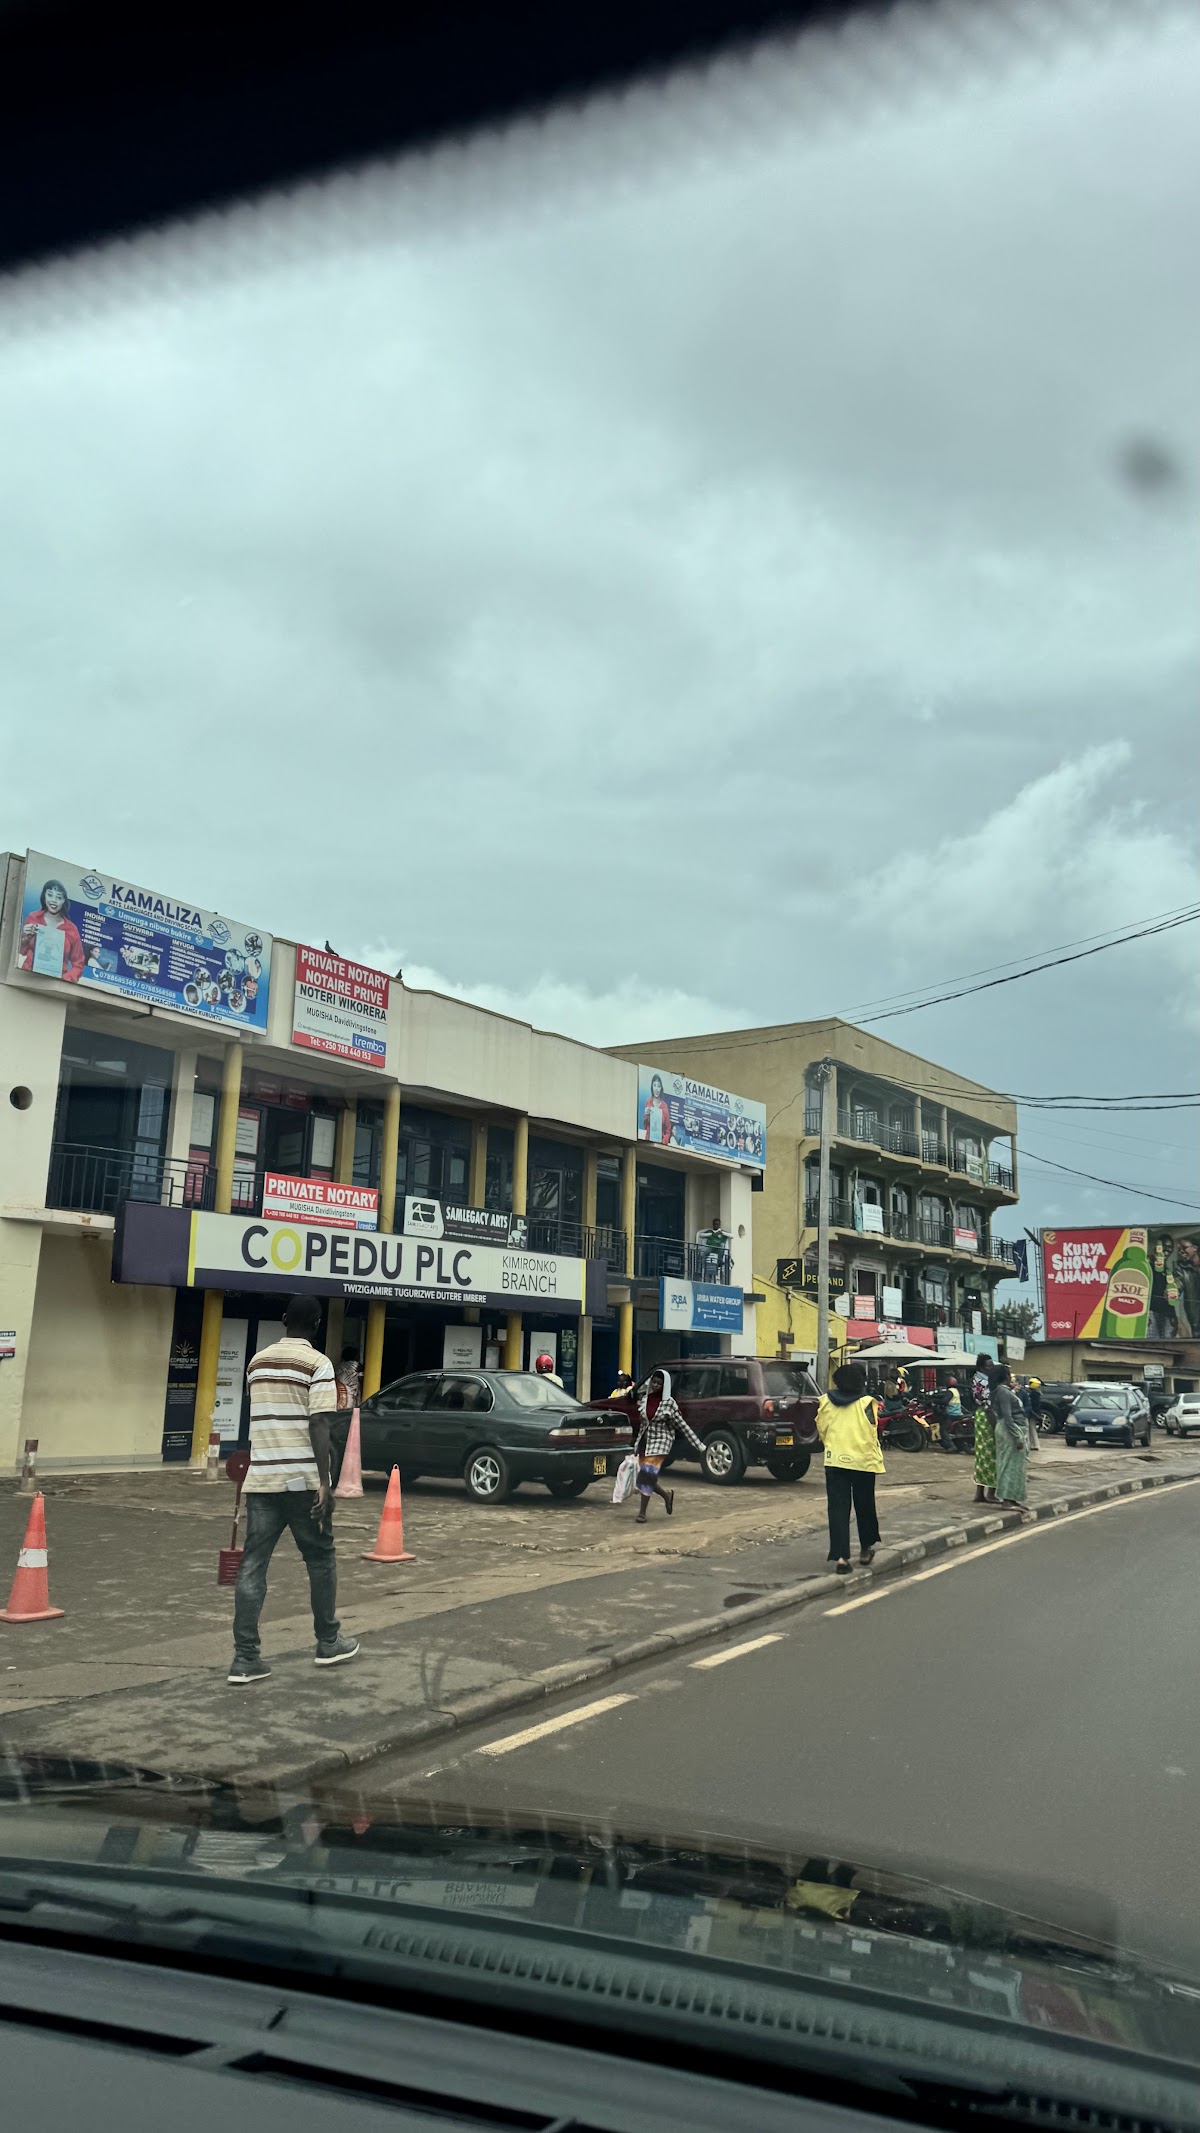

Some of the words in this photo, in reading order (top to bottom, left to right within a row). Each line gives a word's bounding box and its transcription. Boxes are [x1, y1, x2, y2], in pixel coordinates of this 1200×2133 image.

[111, 884, 202, 928] KAMALIZA
[84, 911, 106, 923] INDIMI
[118, 910, 148, 928] Umwuga
[149, 921, 170, 934] nibwo
[170, 927, 192, 941] bukire
[164, 915, 184, 930] DRIVING
[122, 923, 154, 937] GUTWARA
[172, 939, 194, 950] IMYUGA
[301, 949, 345, 976] PRIVATE
[348, 966, 387, 990] NOTARY
[306, 969, 352, 996] NOTAIRE
[354, 986, 382, 1006] PRIVE
[300, 984, 336, 1005] NOTERI
[338, 996, 386, 1021] WIKORERA
[306, 1007, 333, 1022] MUGISHA
[334, 1015, 376, 1034] Davidlivingstone
[310, 1036, 320, 1046] Tel:
[322, 1040, 336, 1051] +250
[338, 1044, 348, 1054] 788
[350, 1048, 360, 1058] 440
[362, 1052, 372, 1060] 153
[685, 1081, 730, 1106] KAMALIZA
[268, 1178, 324, 1200] PRIVATE
[327, 1188, 376, 1208] NOTARY
[289, 1202, 314, 1214] MUGISHA
[316, 1206, 356, 1219] Davidlivingstone
[446, 1206, 490, 1226] SAMLEGACY
[490, 1214, 508, 1228] ARTS
[242, 1225, 402, 1280] COPEDU
[416, 1244, 472, 1286] PLC
[1063, 1242, 1106, 1256] KURYA
[502, 1256, 556, 1274] KIMIRONKO
[1052, 1254, 1098, 1270] SHOW
[502, 1272, 556, 1293] BRANCH
[1112, 1284, 1147, 1296] SKOL
[342, 1284, 392, 1296] TWIZIGAMIRE
[394, 1287, 436, 1300] TUGURIZWE
[436, 1290, 462, 1302] DUTERE
[463, 1293, 486, 1304] IMBERE
[710, 1295, 724, 1304] WATER
[726, 1298, 742, 1306] GROUP
